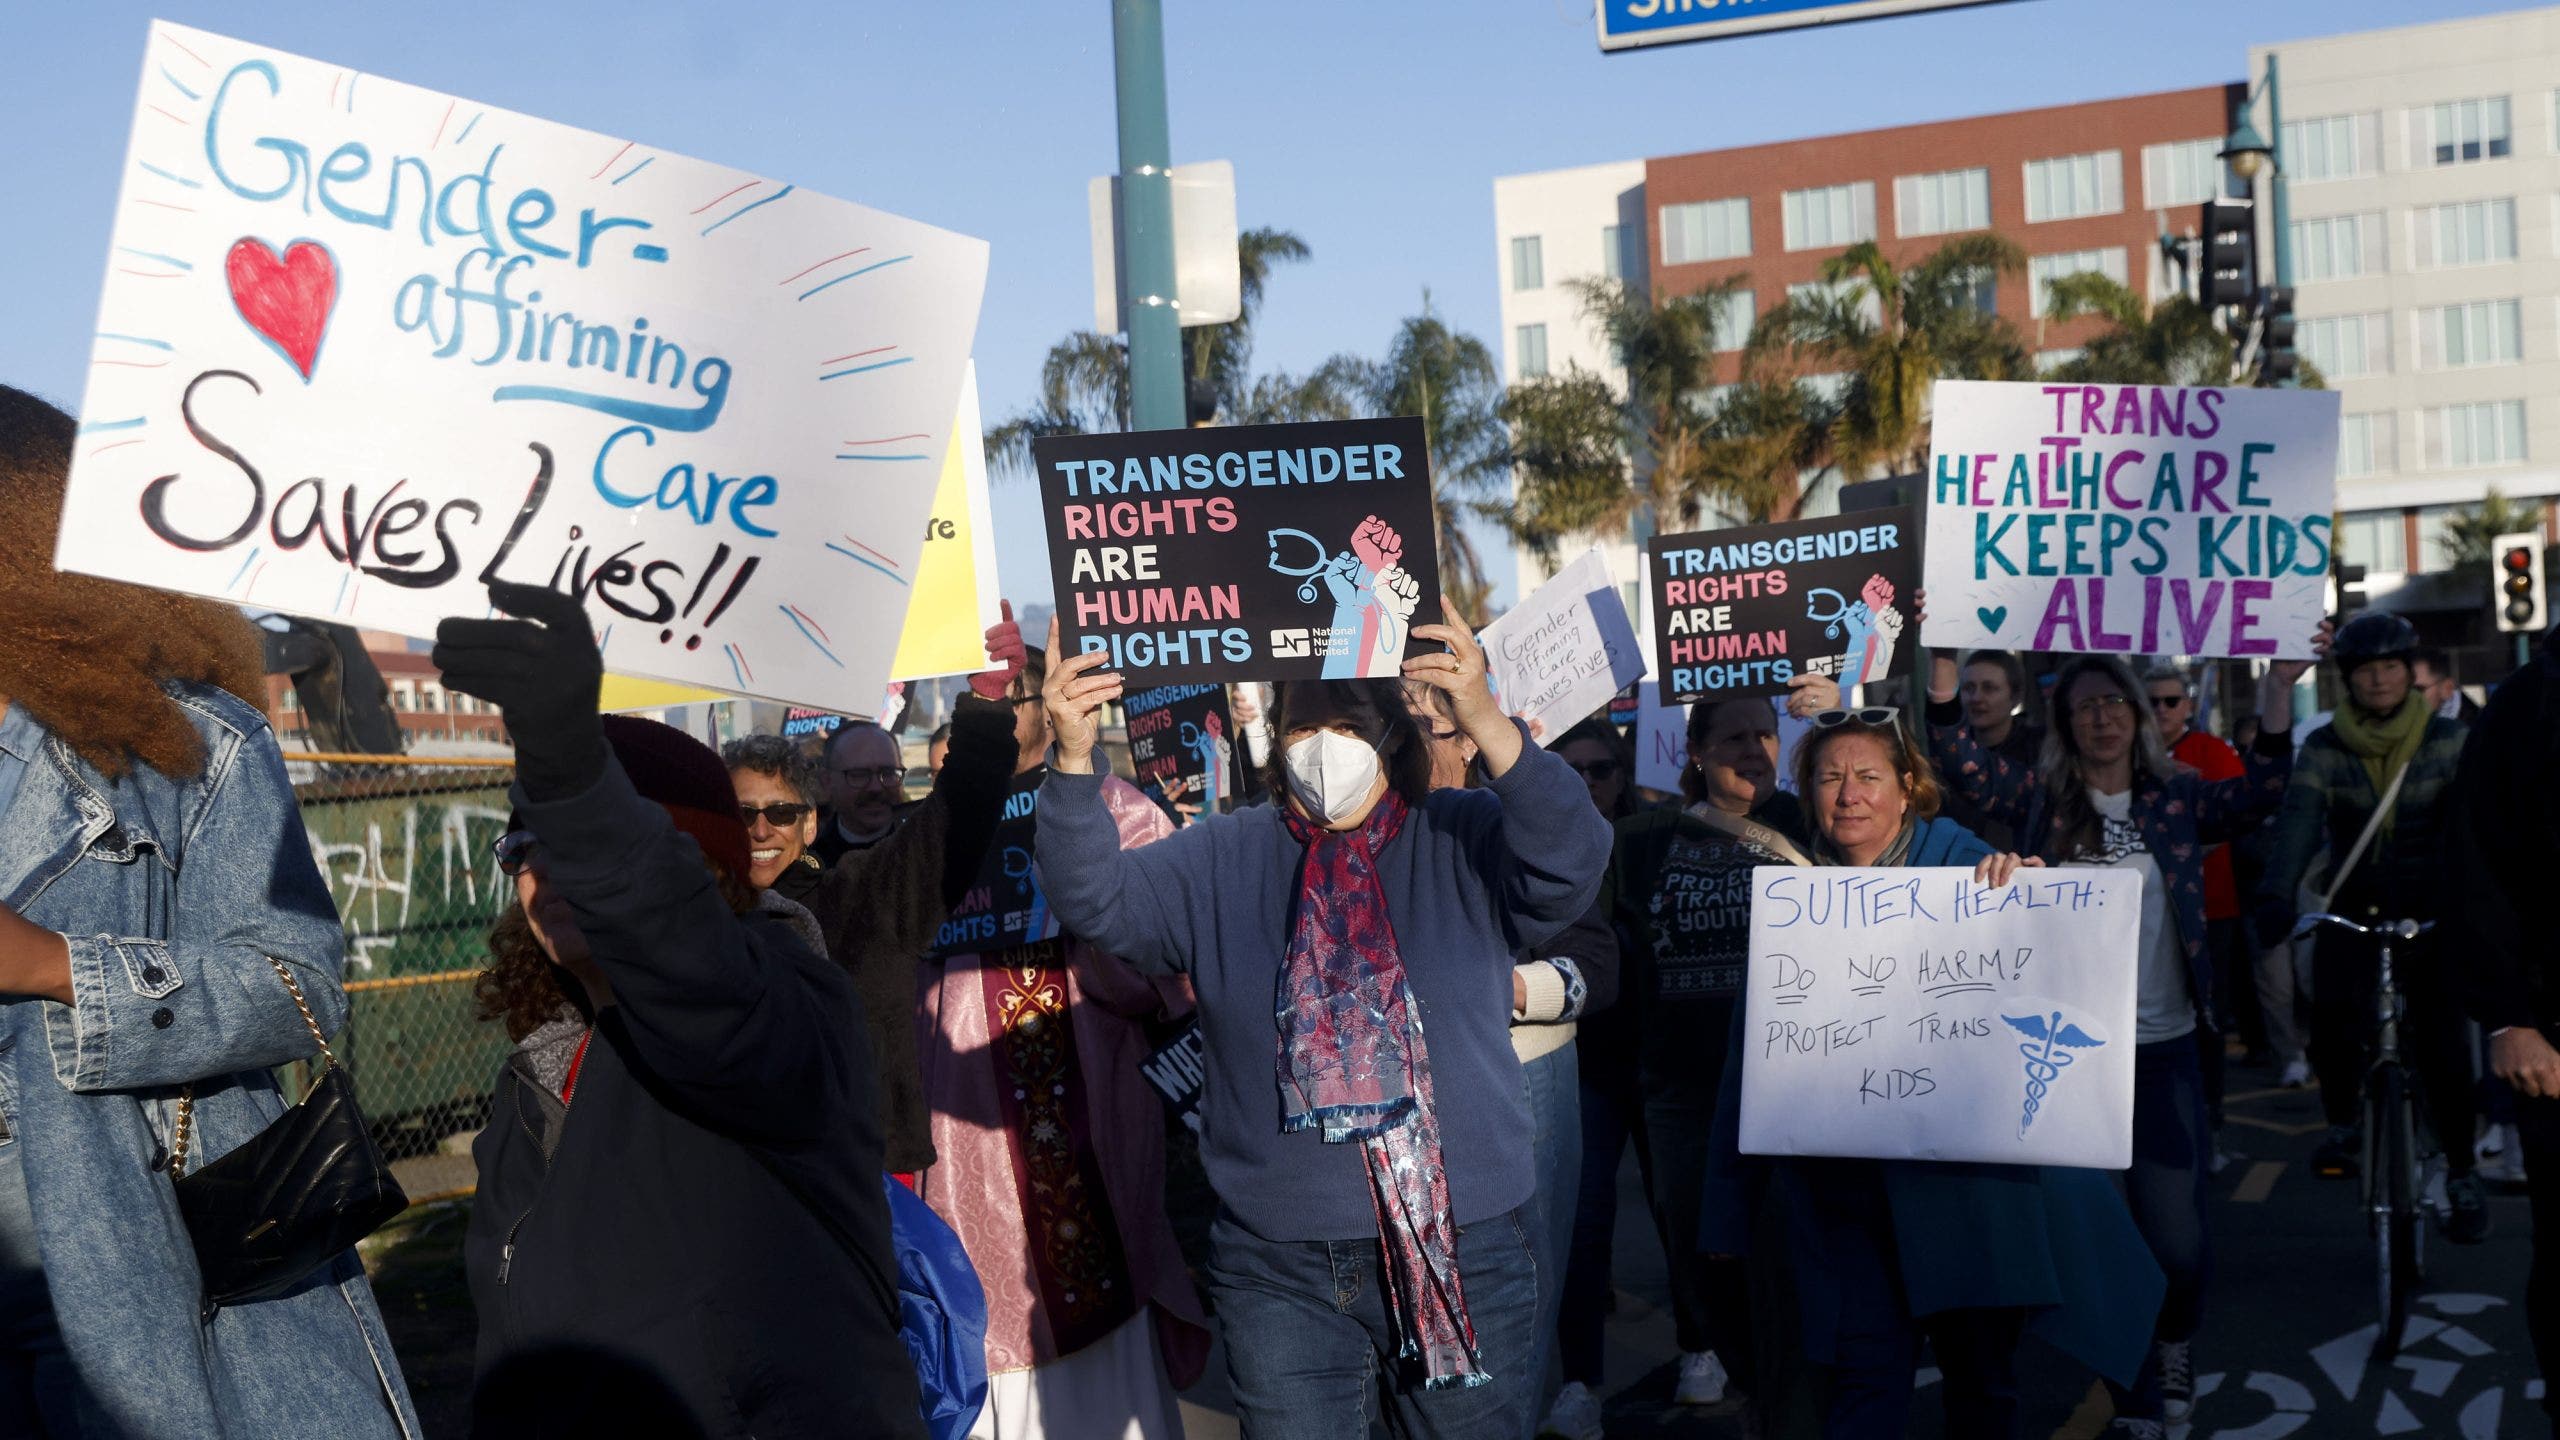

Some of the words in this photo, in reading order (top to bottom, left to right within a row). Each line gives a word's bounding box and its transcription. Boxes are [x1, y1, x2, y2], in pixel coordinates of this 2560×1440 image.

[205, 60, 671, 272] Gender-
[394, 247, 732, 432] affirming
[2041, 386, 2225, 439] TRANS
[594, 426, 779, 539] Care
[1055, 443, 1405, 497] TRANSGENDER
[1937, 437, 2275, 513] HEALTHCARE
[140, 370, 481, 588] Saves
[478, 441, 761, 651] Lives!!
[925, 518, 955, 541] re
[1063, 496, 1238, 540] RIGHTS
[1071, 544, 1161, 584] ARE
[1661, 523, 1899, 576] TRANSGENDER
[1974, 512, 2170, 580] KEEPS
[2199, 514, 2332, 579] KIDS
[1074, 584, 1241, 627] HUMAN
[1665, 569, 1789, 606] RIGHTS
[1312, 626, 1356, 637] National
[1502, 602, 1578, 662] Gender
[1667, 605, 1733, 636] ARE
[2033, 576, 2279, 656] ALIVE
[1080, 627, 1252, 670] RIGHTS
[1313, 637, 1349, 647] Nurses
[1314, 647, 1349, 657] United
[1670, 630, 1787, 665] HUMAN
[1672, 658, 1794, 693] RIGHTS
[785, 715, 841, 736] RIGHTS
[1130, 709, 1172, 738] RIGHTS
[1134, 738, 1155, 761] ARE
[1665, 867, 1752, 892] PROTEC
[1765, 876, 1938, 929] SUTTER
[1954, 879, 2105, 924] HEALTH:
[932, 912, 997, 948] GHTS
[1848, 955, 1896, 983] NO
[1918, 948, 2032, 986] HARM!
[1766, 1015, 1887, 1059] PROTECT
[1908, 1012, 1991, 1044] TRANS
[1860, 1067, 1936, 1105] KIDS
